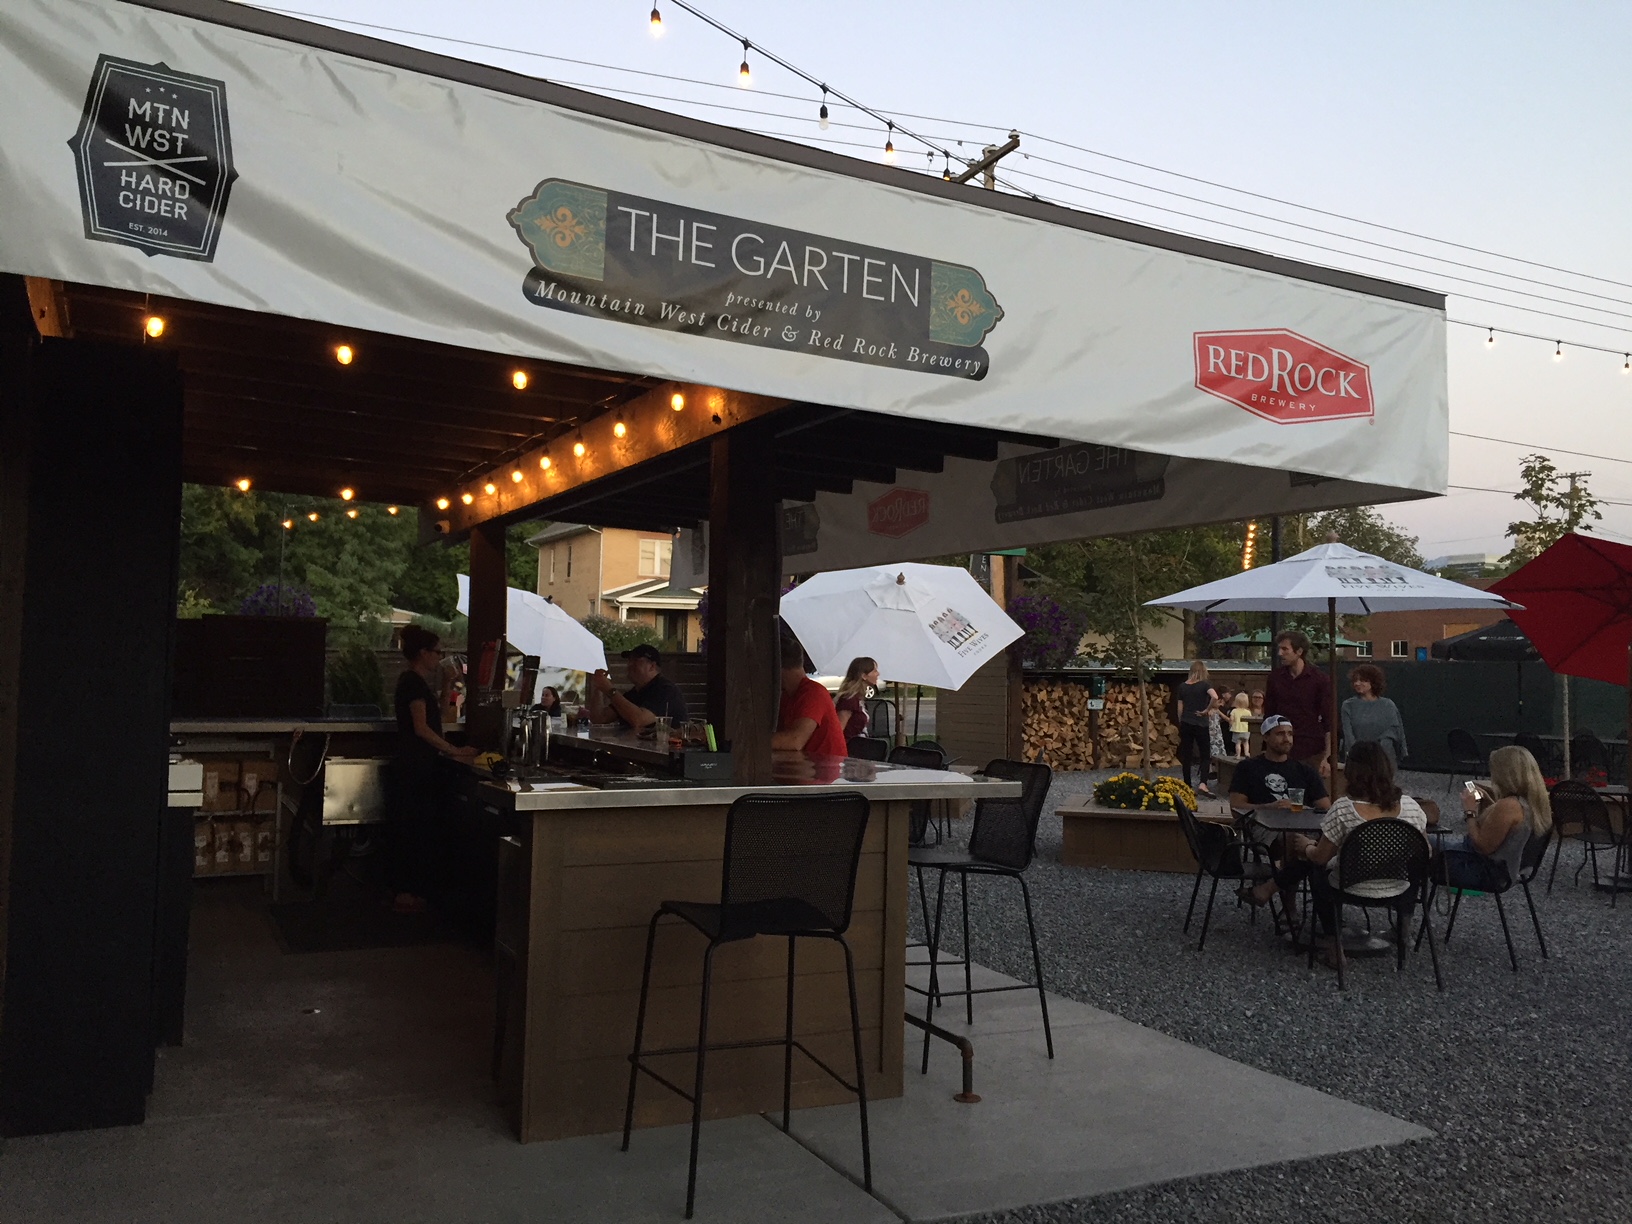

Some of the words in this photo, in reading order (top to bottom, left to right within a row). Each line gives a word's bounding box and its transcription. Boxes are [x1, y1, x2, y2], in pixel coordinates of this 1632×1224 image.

[128, 97, 190, 130] MTN
[124, 123, 189, 155] WST
[120, 169, 190, 200] HARD
[118, 190, 188, 221] CIDER
[128, 222, 145, 233] EST.
[148, 226, 168, 237] 2014
[617, 205, 717, 268] THE
[731, 232, 920, 307] GARTEN
[725, 291, 798, 316] presented
[805, 301, 821, 322] by
[534, 279, 646, 316] Mountain
[660, 301, 706, 327] West
[716, 313, 772, 338] Cider
[781, 325, 799, 342] &
[808, 329, 844, 351] Red
[852, 337, 898, 359] Rock
[907, 346, 981, 376] Brewery
[1251, 393, 1316, 412] BREWERY
[957, 646, 973, 658] FIVE
[969, 633, 989, 647] WIVES
